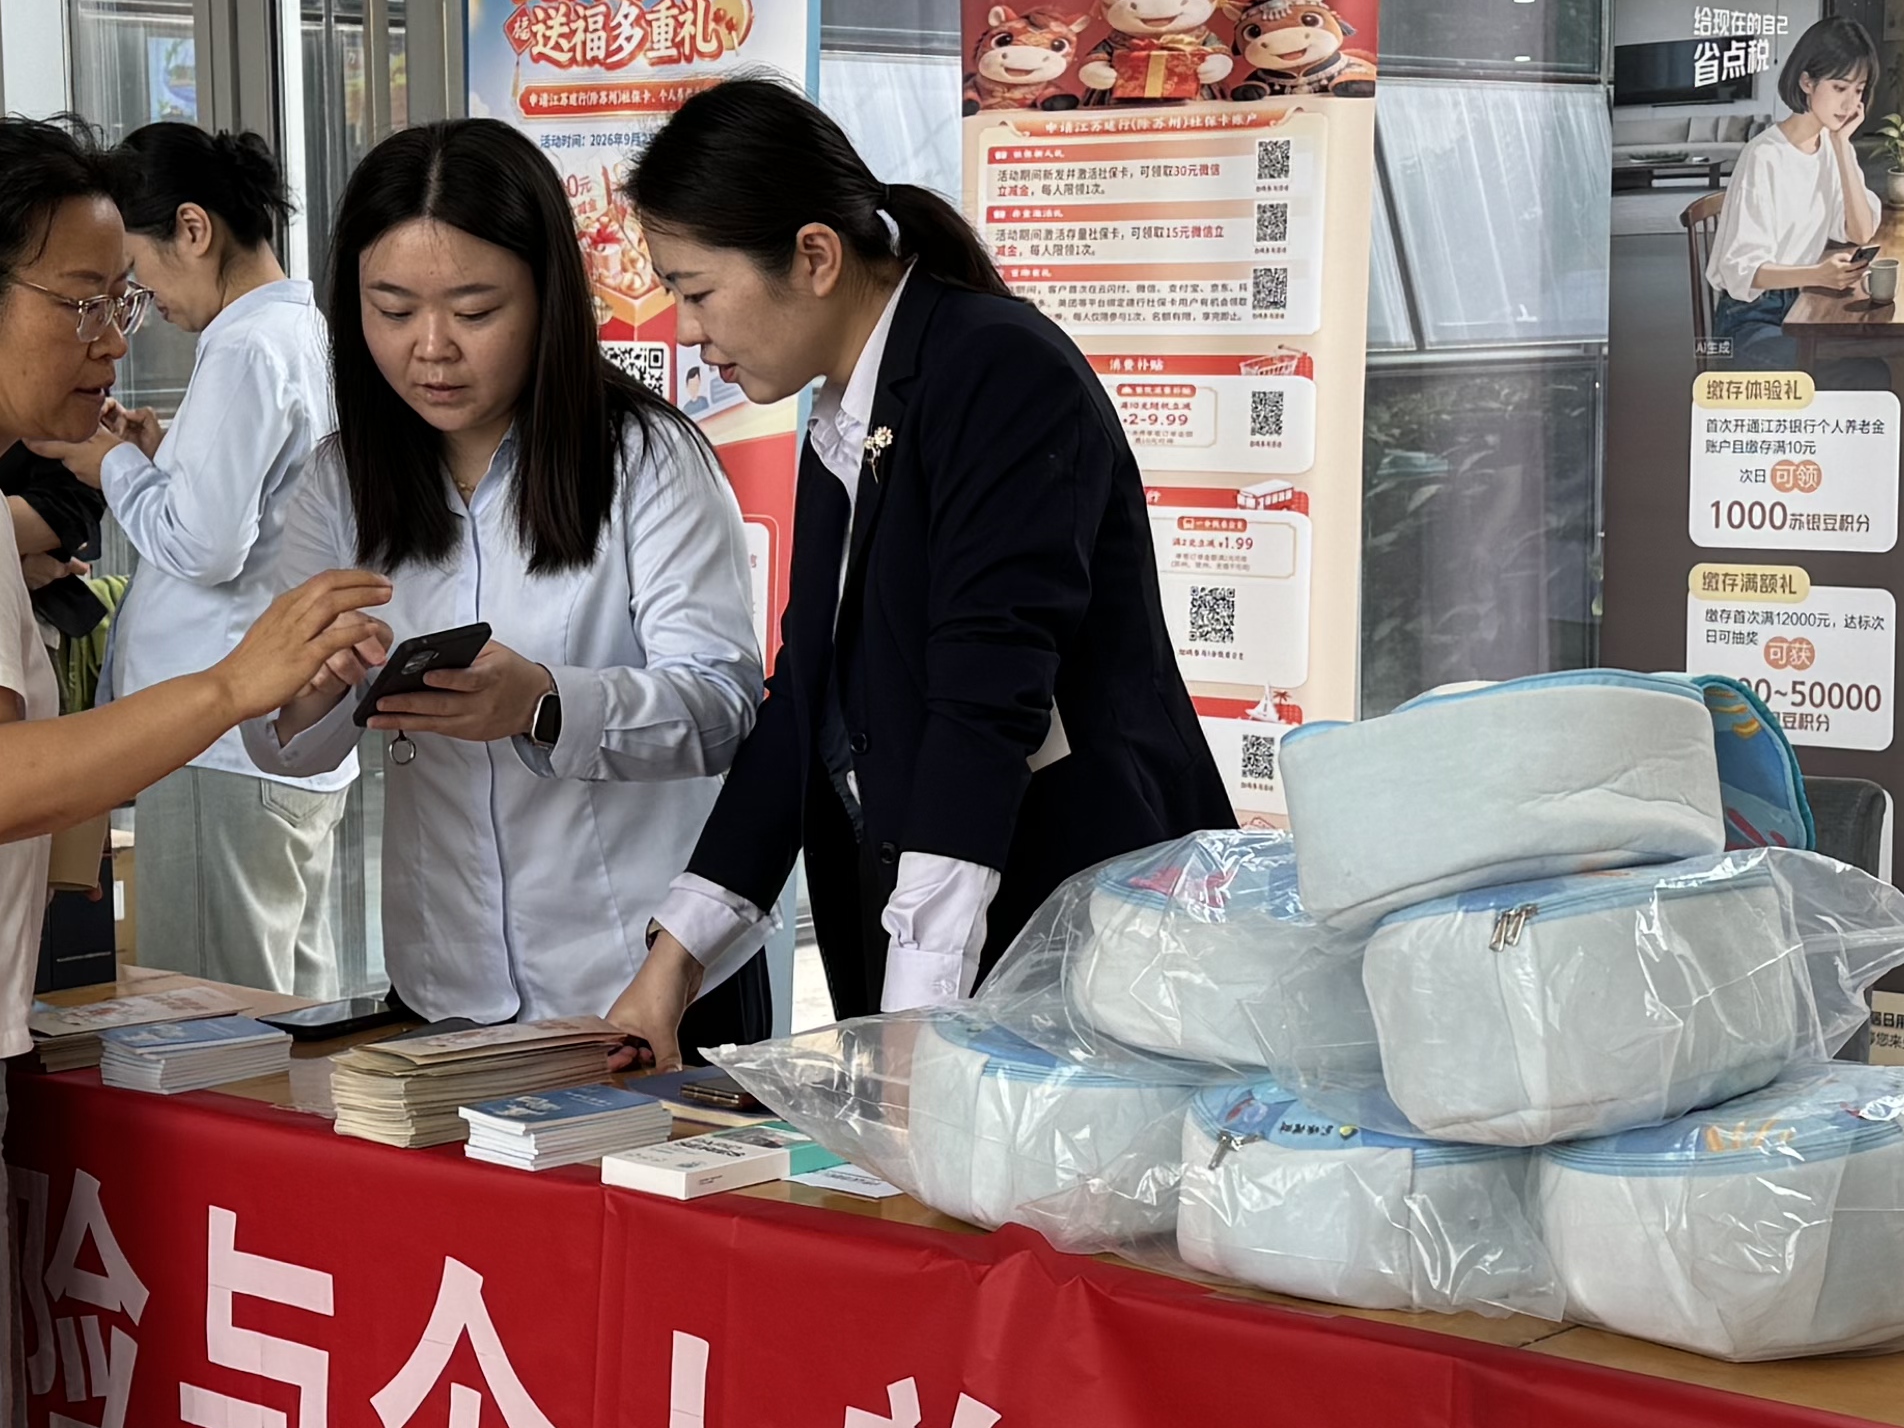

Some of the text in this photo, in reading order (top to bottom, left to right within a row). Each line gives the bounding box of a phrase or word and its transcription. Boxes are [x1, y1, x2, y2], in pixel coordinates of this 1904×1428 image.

[530, 0, 724, 66] 送福多重礼
[1693, 5, 1790, 37] 给现在的自己
[1693, 38, 1770, 88] 省点税
[1706, 379, 1803, 401] 缴存体验礼
[1705, 418, 1886, 435] 首次开通江苏银行个人养老金
[1704, 439, 1817, 455] 账户且缴存满10元
[1739, 464, 1818, 489] 次日 可领
[1702, 571, 1797, 595] 缴存满额礼
[1705, 608, 1885, 631] 缴存首次满12000元，达标次
[1705, 629, 1758, 646] 日可抽奖
[1769, 640, 1812, 666] 可获
